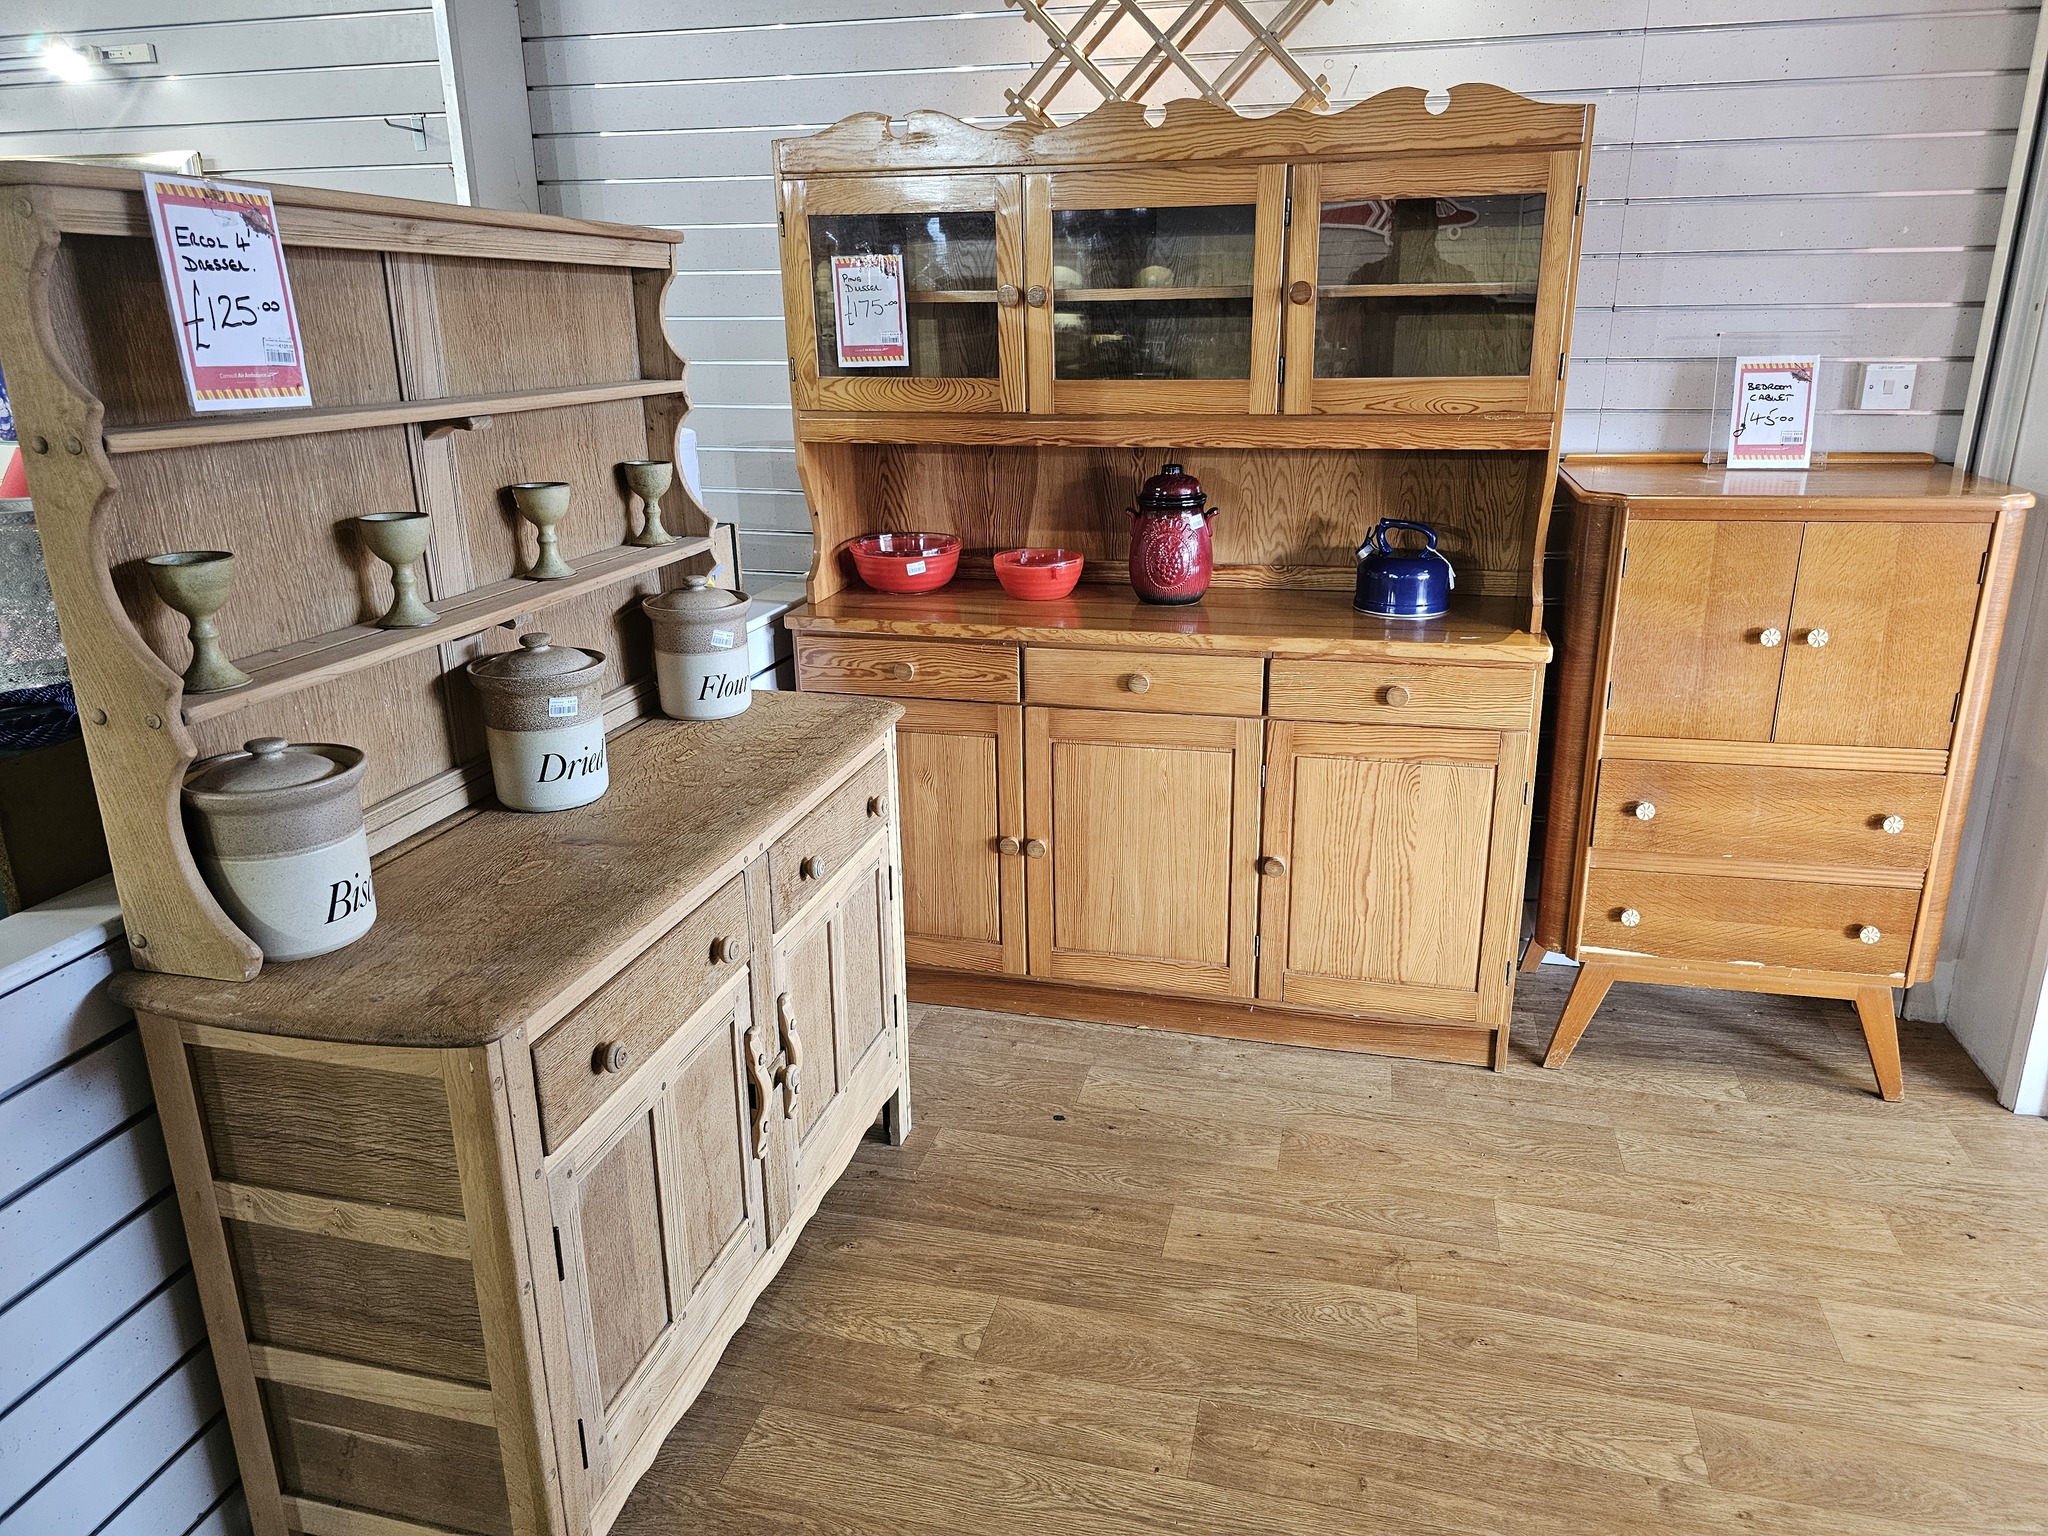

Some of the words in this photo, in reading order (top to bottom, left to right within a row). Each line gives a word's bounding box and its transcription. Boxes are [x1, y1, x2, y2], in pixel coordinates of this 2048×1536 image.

[1747, 382, 1793, 391] BEDROOM
[697, 673, 750, 701] Flour
[536, 738, 604, 783] Dried
[323, 872, 374, 926] Bisc
